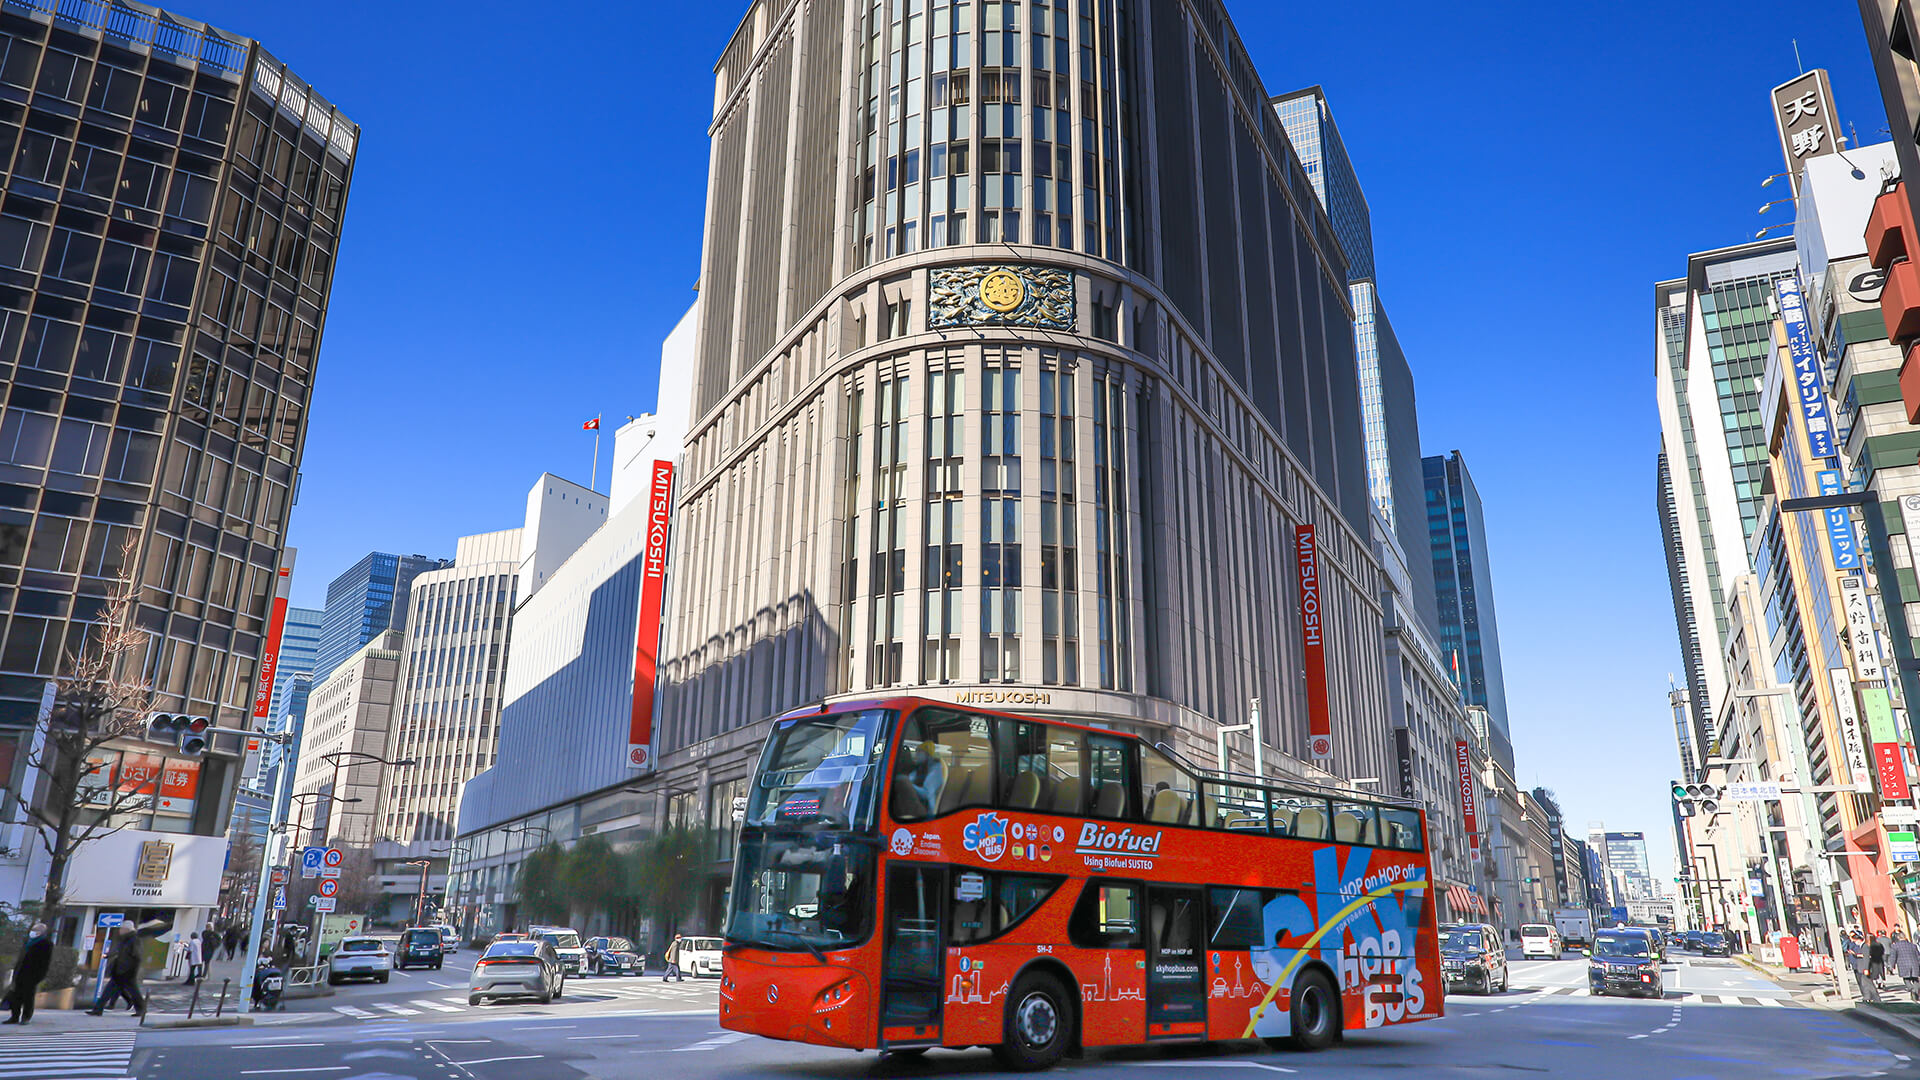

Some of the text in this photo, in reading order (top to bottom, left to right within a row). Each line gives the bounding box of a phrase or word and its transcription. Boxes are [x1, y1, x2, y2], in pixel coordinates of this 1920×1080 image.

[1783, 90, 1825, 158] 天野
[1790, 337, 1802, 357] パレス
[1796, 357, 1827, 433] イタリア語
[1815, 433, 1828, 454] チャオ
[647, 467, 669, 578] MITSUKOSHI
[1299, 532, 1320, 646] MITSUKOSHI
[1849, 593, 1874, 663] 天野歯科
[256, 653, 274, 702] むさし証券
[1863, 668, 1877, 676] 3F
[956, 691, 1051, 705] MITSUKOSHI
[1457, 745, 1474, 816] MITSUKOSHI
[963, 812, 1009, 851] SKY
[979, 836, 997, 848] HOP
[1077, 821, 1162, 852] Biofuel
[985, 844, 1002, 857] BUS
[1083, 856, 1153, 870] Using Biofuel SUSTEO
[131, 888, 163, 896] TOYAMA
[1339, 863, 1416, 904] HOP on HOP off
[1037, 945, 1053, 953] SH-2
[1336, 929, 1402, 992] HOP
[1156, 964, 1199, 974] skyhopbus.com
[1364, 967, 1425, 1029] BUS
